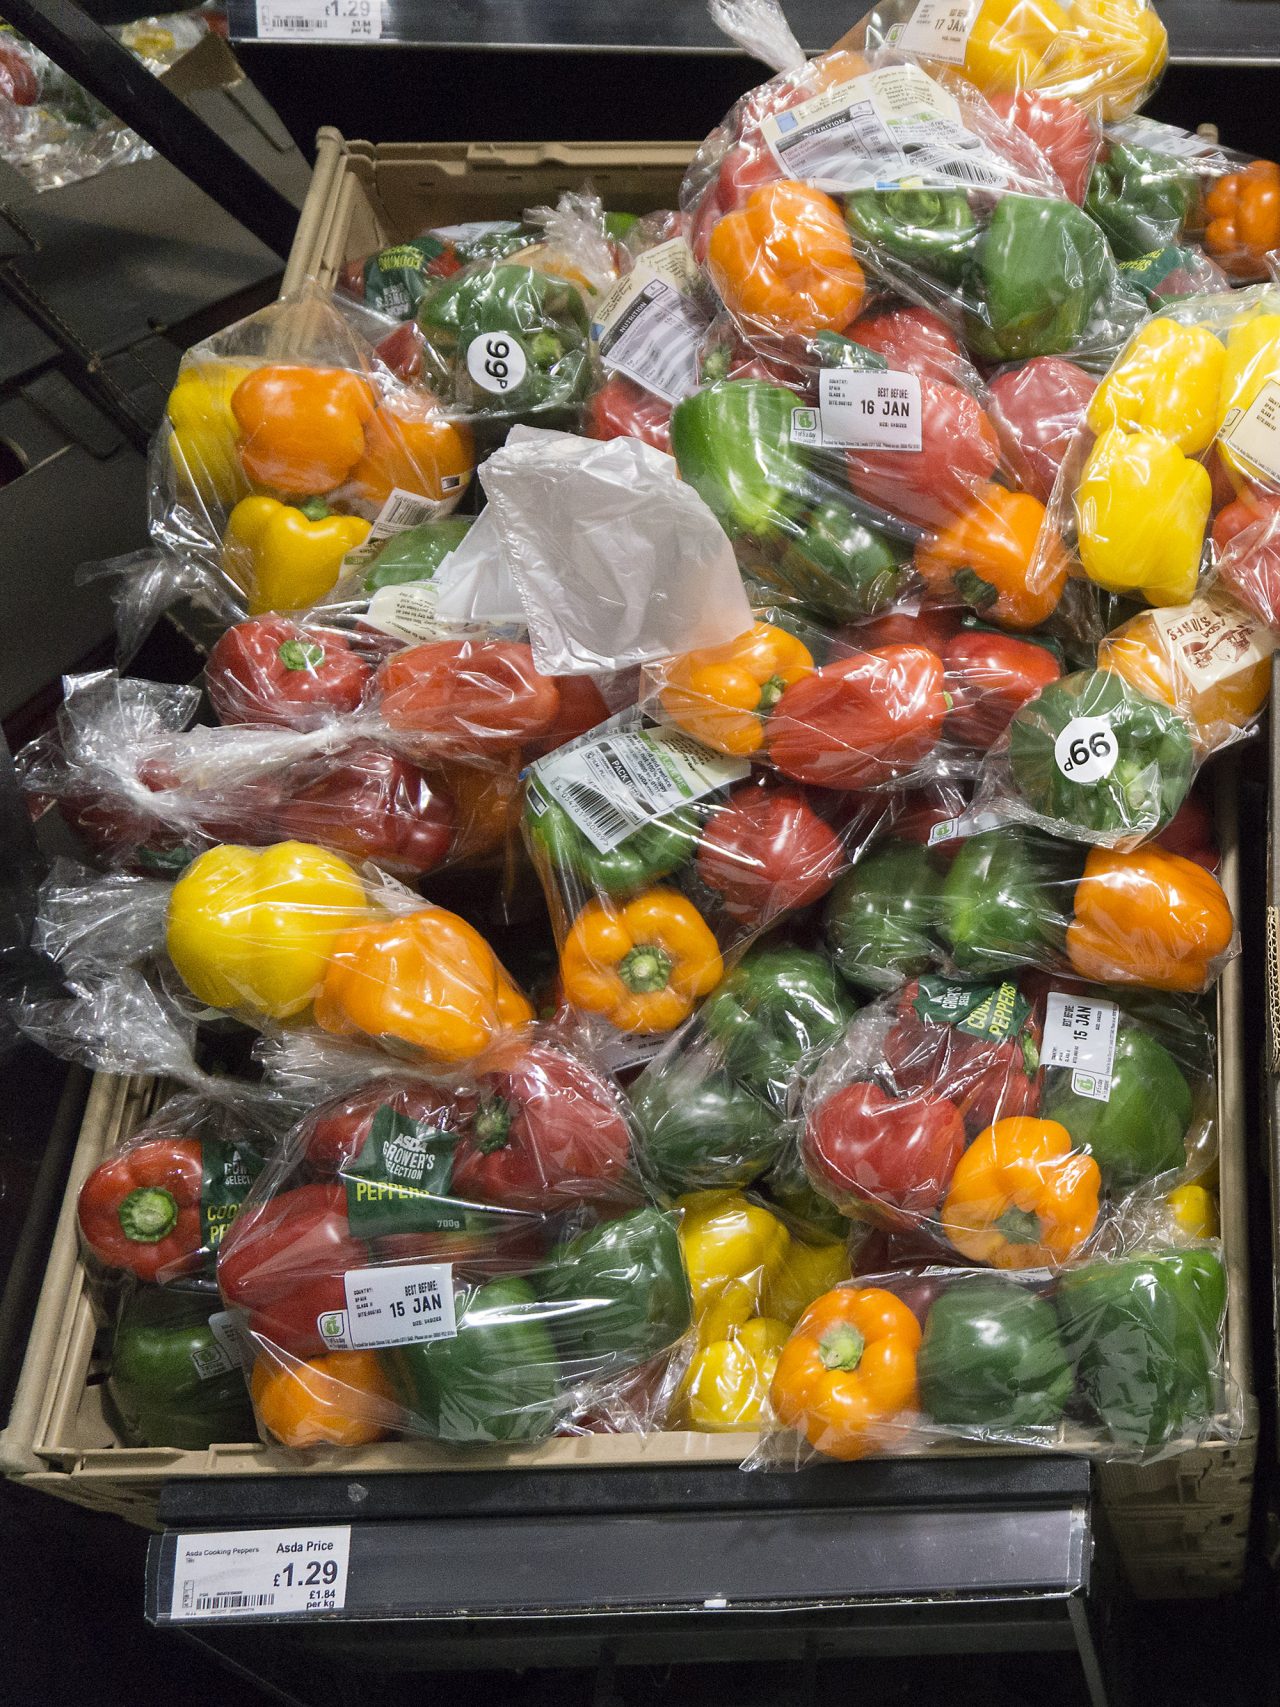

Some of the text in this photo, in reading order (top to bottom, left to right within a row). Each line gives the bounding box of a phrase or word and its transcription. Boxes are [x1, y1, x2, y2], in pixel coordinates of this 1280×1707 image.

[935, 19, 945, 30] 17
[619, 301, 648, 333] NUTRITION
[877, 387, 910, 400] BEST BEFORE:
[860, 399, 910, 417] 16 JAN
[612, 760, 630, 784] PACK
[988, 982, 1017, 1037] PEPPERS
[1075, 1006, 1092, 1027] JAN
[1062, 1016, 1073, 1028] BEST
[1073, 1030, 1088, 1041] 15
[392, 1132, 429, 1153] ASDA
[382, 1140, 436, 1170] GROWER'S
[437, 1219, 460, 1229] 700g
[405, 1280, 438, 1297] BEST BEFORE:
[389, 1301, 406, 1318] 15
[413, 1293, 442, 1314] JAN
[233, 1547, 259, 1555] Peppers
[276, 1540, 334, 1554] Asda Price
[273, 1559, 338, 1588] £1.29
[309, 1589, 336, 1599] £1.84
[306, 1599, 335, 1610] per kg
